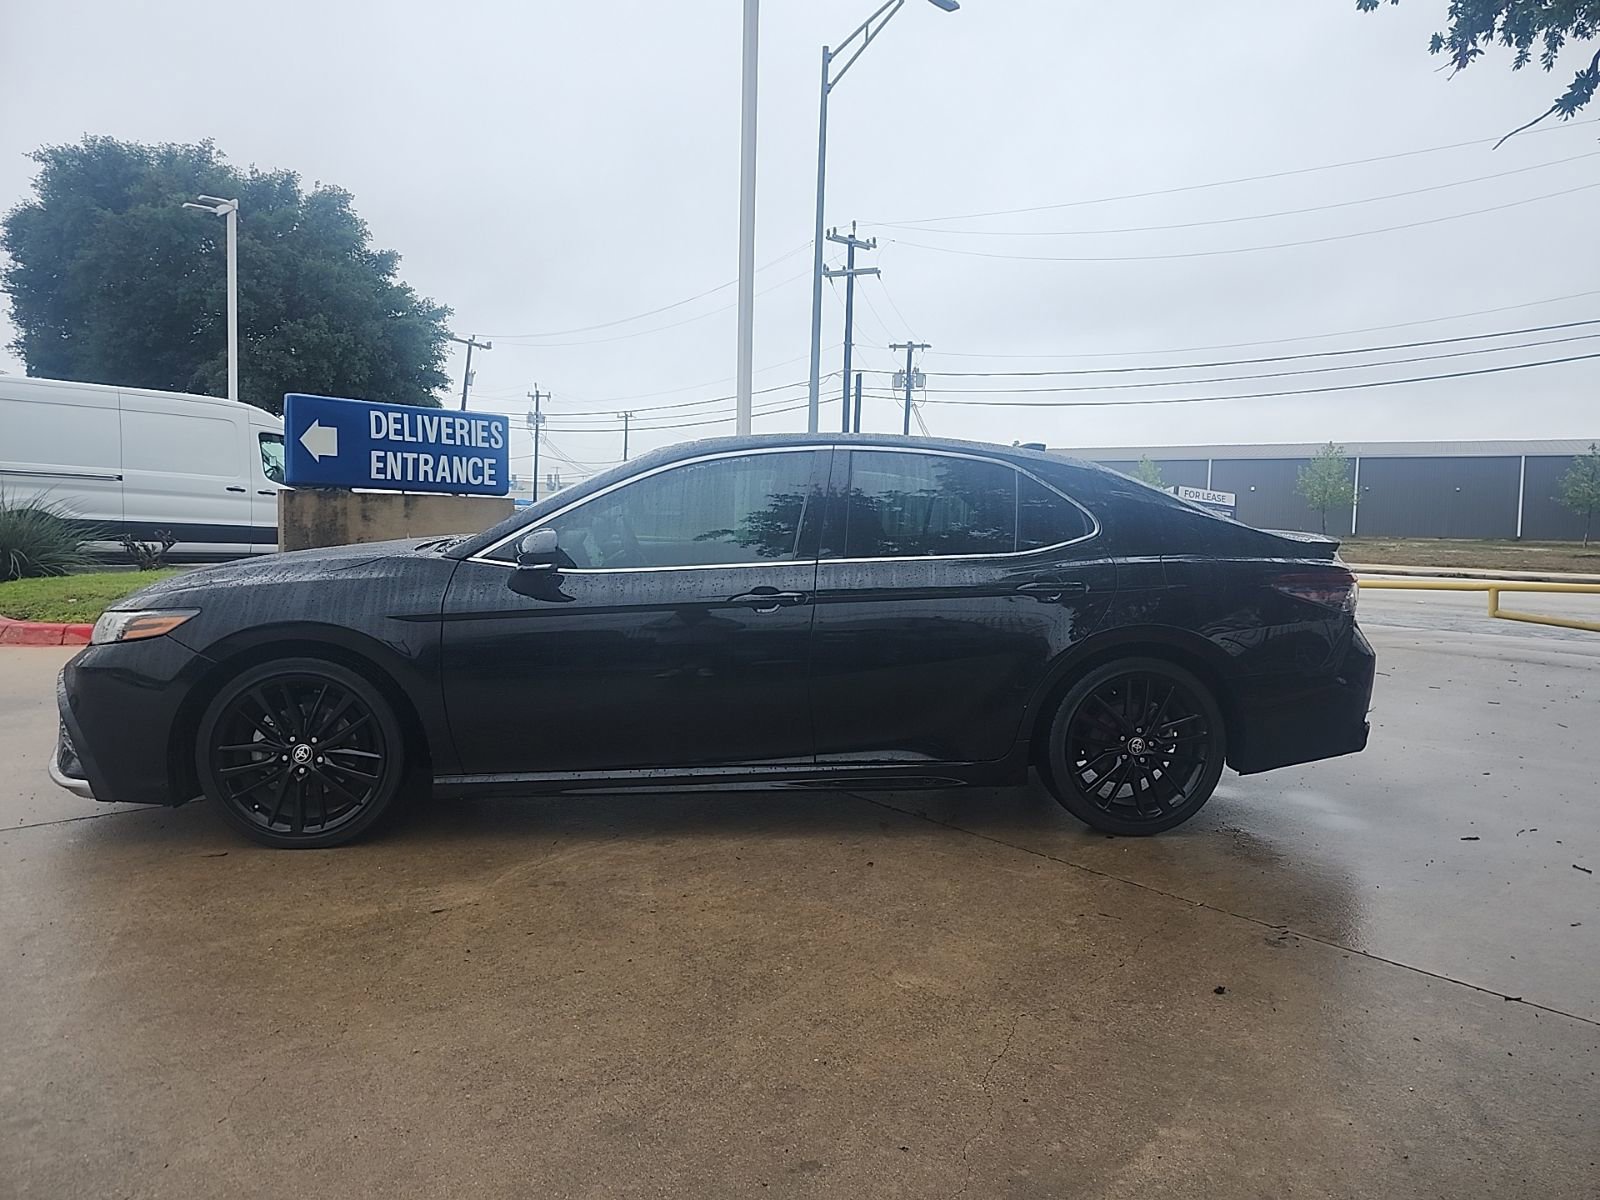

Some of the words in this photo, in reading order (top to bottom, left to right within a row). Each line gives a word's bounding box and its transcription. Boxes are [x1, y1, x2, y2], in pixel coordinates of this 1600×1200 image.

[369, 410, 503, 449] DELIVERIES
[370, 450, 497, 486] ENTRANCE
[1184, 489, 1201, 499] FOR
[1202, 492, 1226, 503] LEASE
